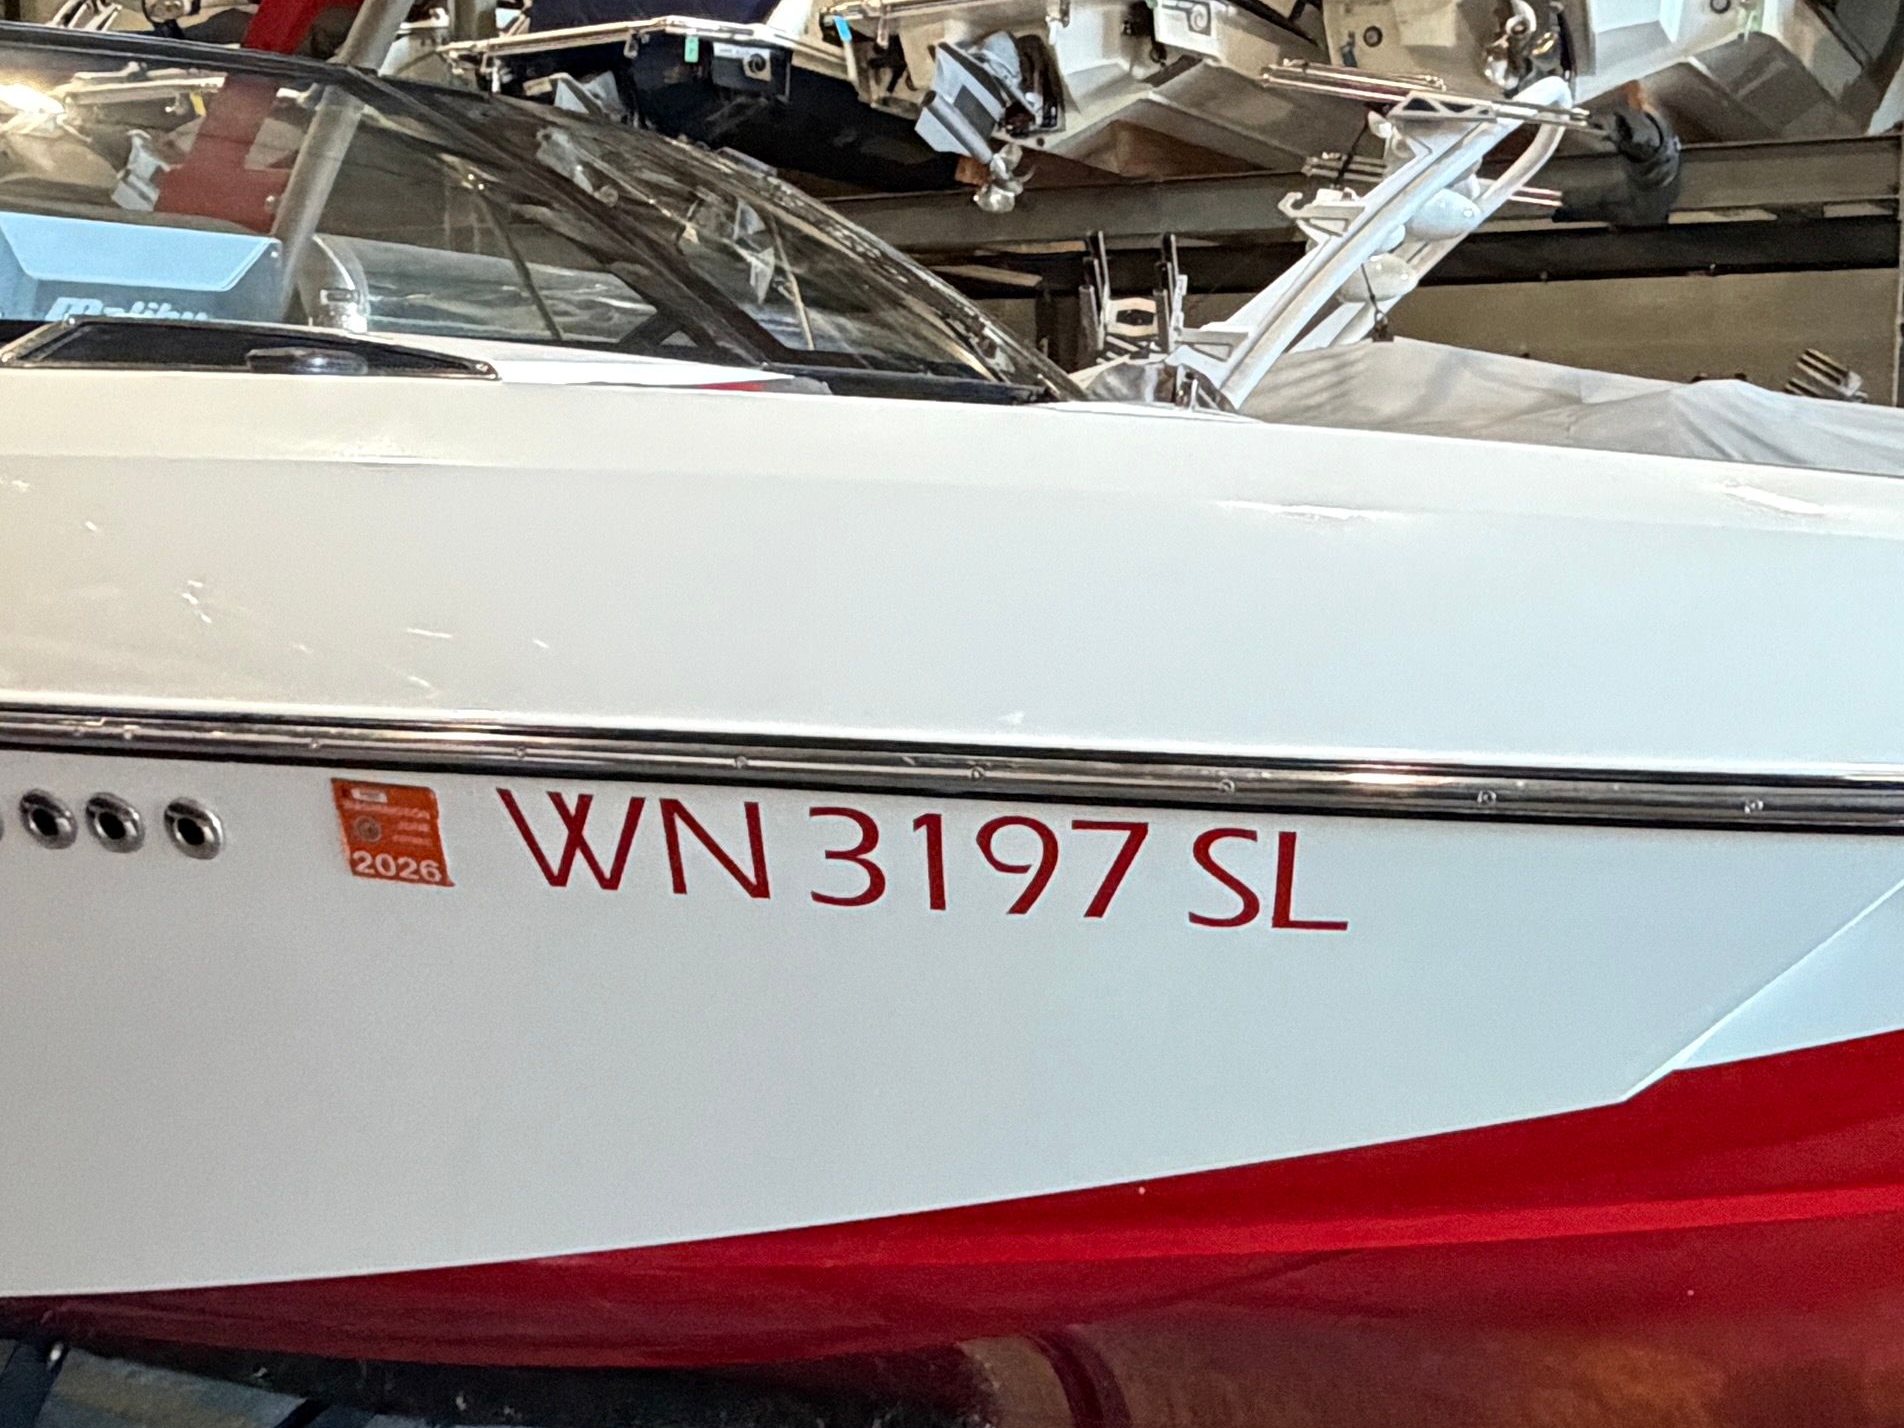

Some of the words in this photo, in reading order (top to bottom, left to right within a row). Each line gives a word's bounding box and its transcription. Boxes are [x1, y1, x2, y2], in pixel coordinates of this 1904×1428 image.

[352, 850, 443, 883] 2026
[496, 788, 772, 899] WN
[808, 805, 1149, 918] 3197
[1188, 826, 1349, 931] SL
